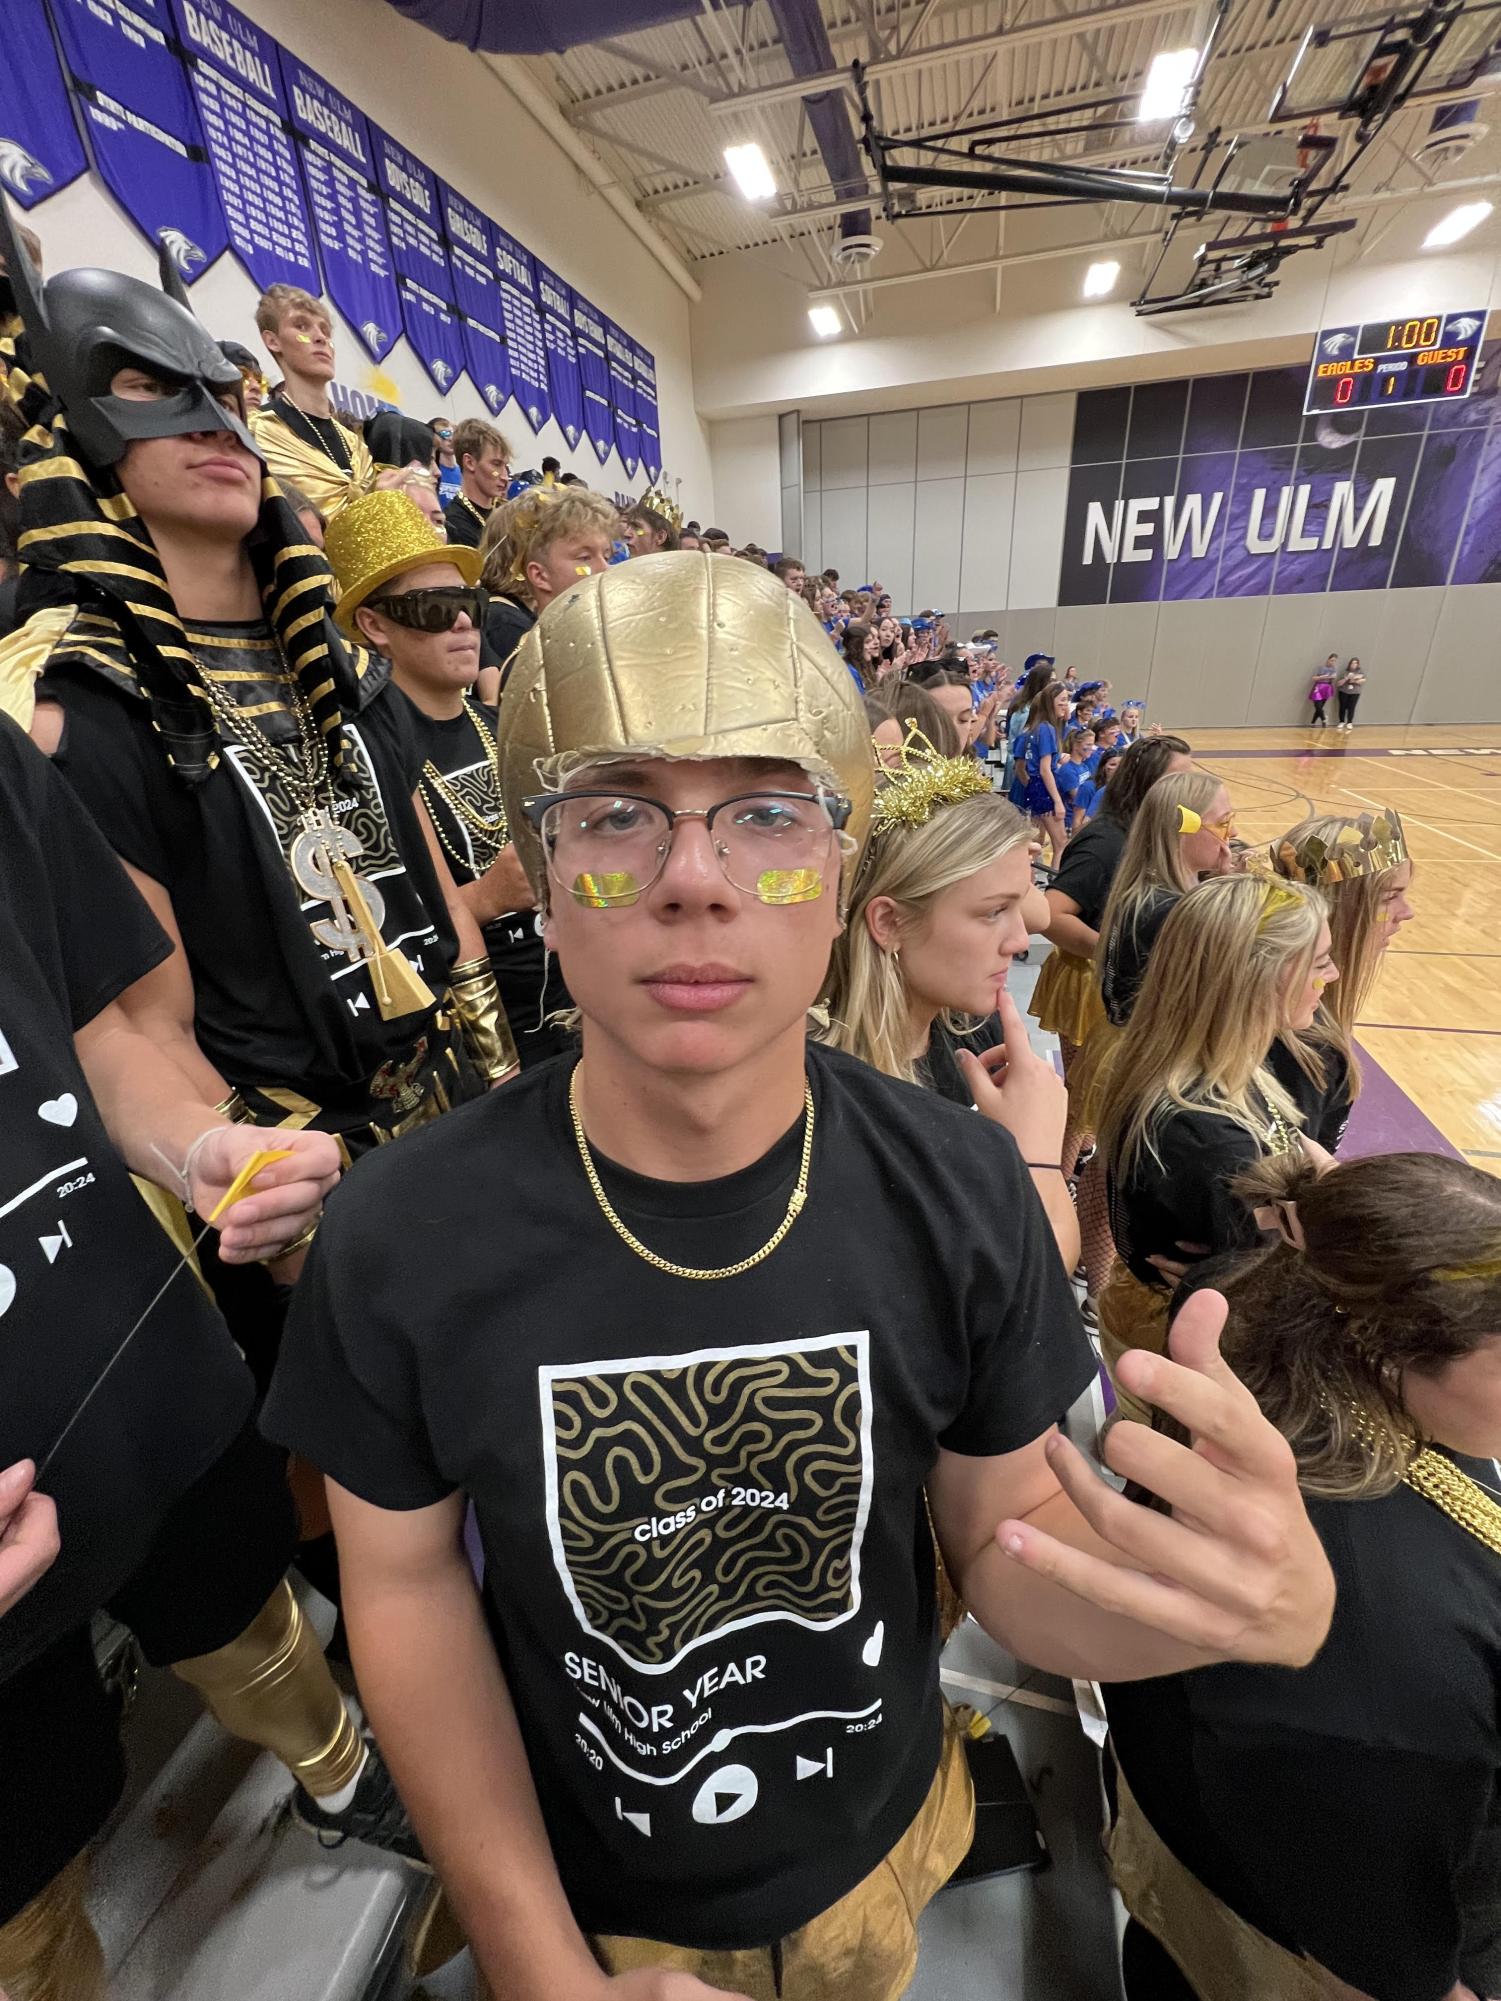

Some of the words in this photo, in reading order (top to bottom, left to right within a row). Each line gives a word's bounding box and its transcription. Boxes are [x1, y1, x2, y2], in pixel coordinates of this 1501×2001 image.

[182, 0, 277, 100] BASEBALL
[227, 13, 260, 53] ULM
[297, 68, 326, 101] NEW
[328, 92, 353, 124] ULM
[292, 83, 367, 164] BASEBALL
[496, 247, 534, 292] SOFTBALL
[1387, 318, 1439, 349] 1:00
[1317, 358, 1375, 377] EAGLES
[1377, 361, 1408, 373] PERIOD
[1417, 347, 1468, 366] GUEST
[1335, 377, 1354, 404] 0
[1386, 376, 1395, 396] 1
[1446, 364, 1466, 392] 0
[1082, 491, 1224, 565] NEW
[1245, 477, 1397, 554] ULM
[56, 1172, 97, 1199] 20:24
[633, 1504, 697, 1542] class
[700, 1488, 726, 1512] of
[731, 1486, 790, 1511] 2024
[564, 1651, 675, 1733] SENIOR
[682, 1654, 767, 1709] YEAR
[624, 1727, 658, 1756] High
[662, 1707, 713, 1754] School
